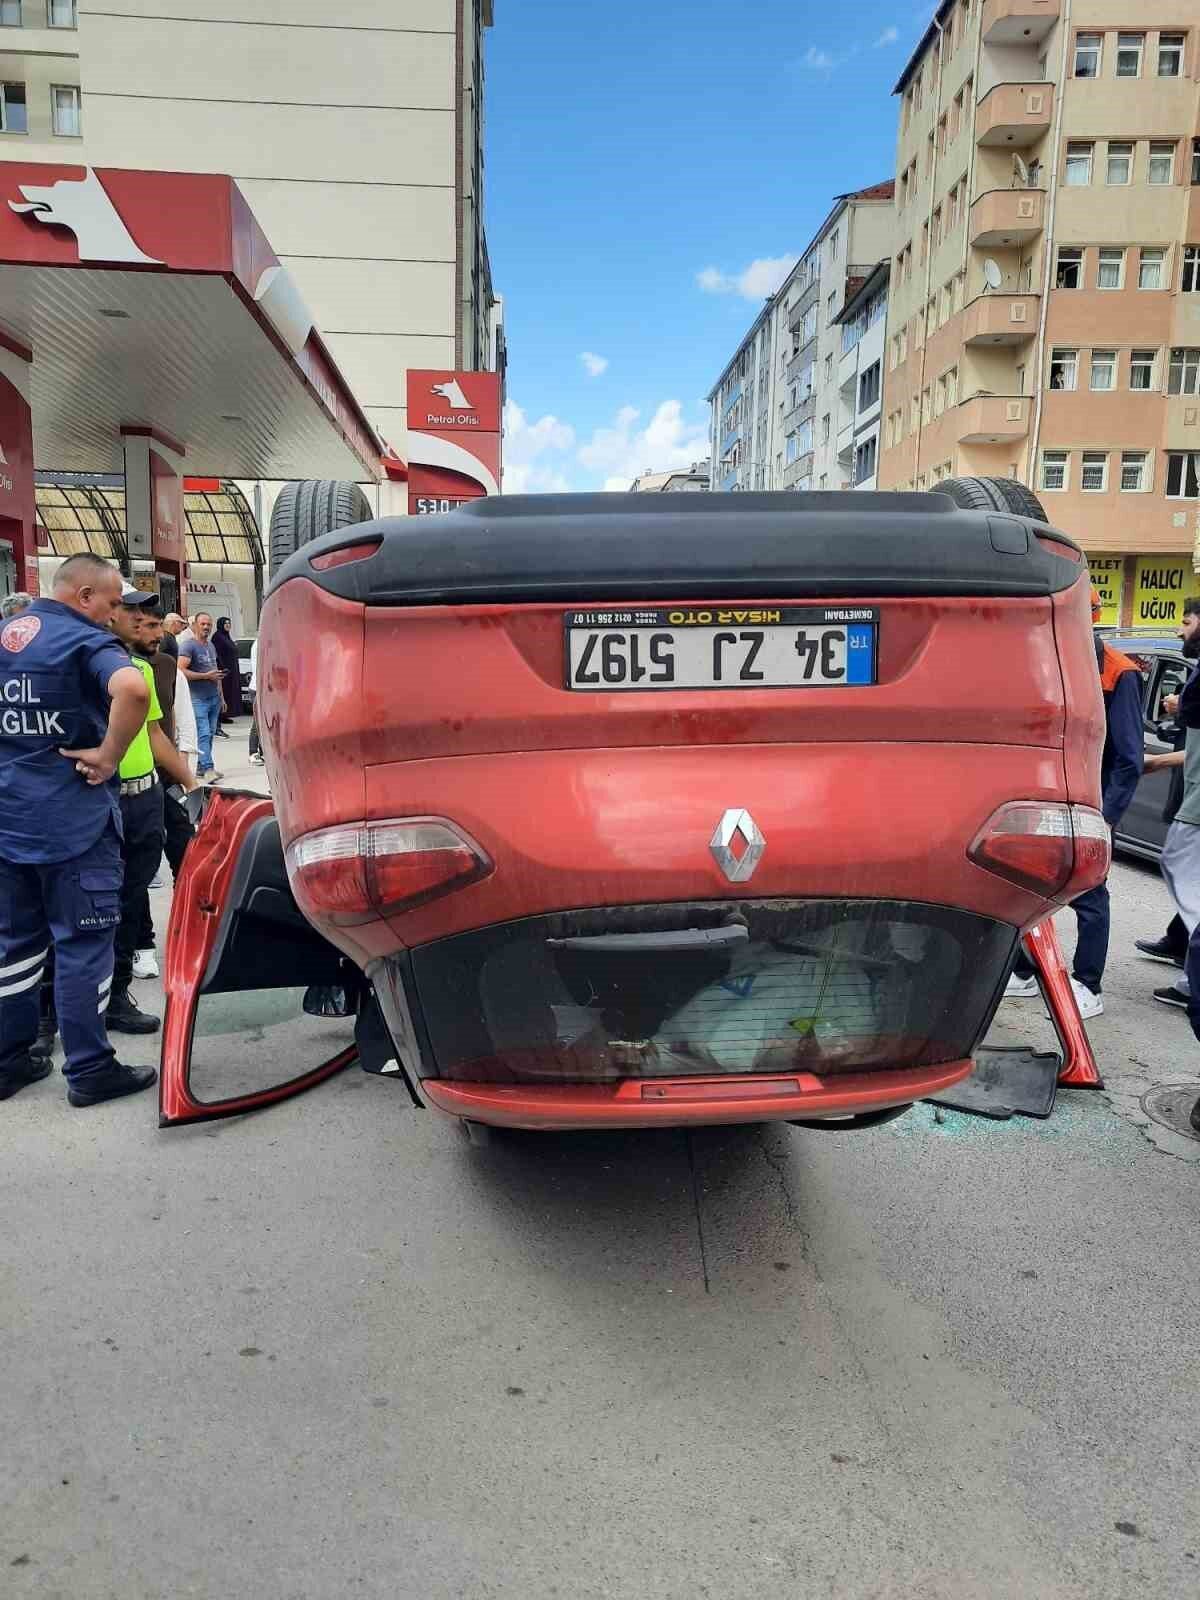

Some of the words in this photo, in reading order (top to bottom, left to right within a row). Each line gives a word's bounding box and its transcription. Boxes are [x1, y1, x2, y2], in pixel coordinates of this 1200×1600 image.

[427, 414, 455, 424] Petrol
[457, 414, 480, 424] Ofisi
[1087, 559, 1122, 570] TLET
[1140, 569, 1183, 590] HALICI
[824, 609, 873, 621] OKMEYDANI
[1140, 596, 1176, 620] UĞUR
[573, 613, 584, 625] 07
[586, 613, 595, 624] 11
[597, 613, 613, 625] 256
[614, 612, 632, 624] 0212
[668, 611, 713, 625] OTO
[849, 635, 869, 649] TR
[575, 632, 675, 683] 5197
[712, 631, 764, 681] ZJ
[794, 630, 846, 680] 34
[0, 672, 41, 704] CİL
[0, 706, 65, 735] ĞLIK
